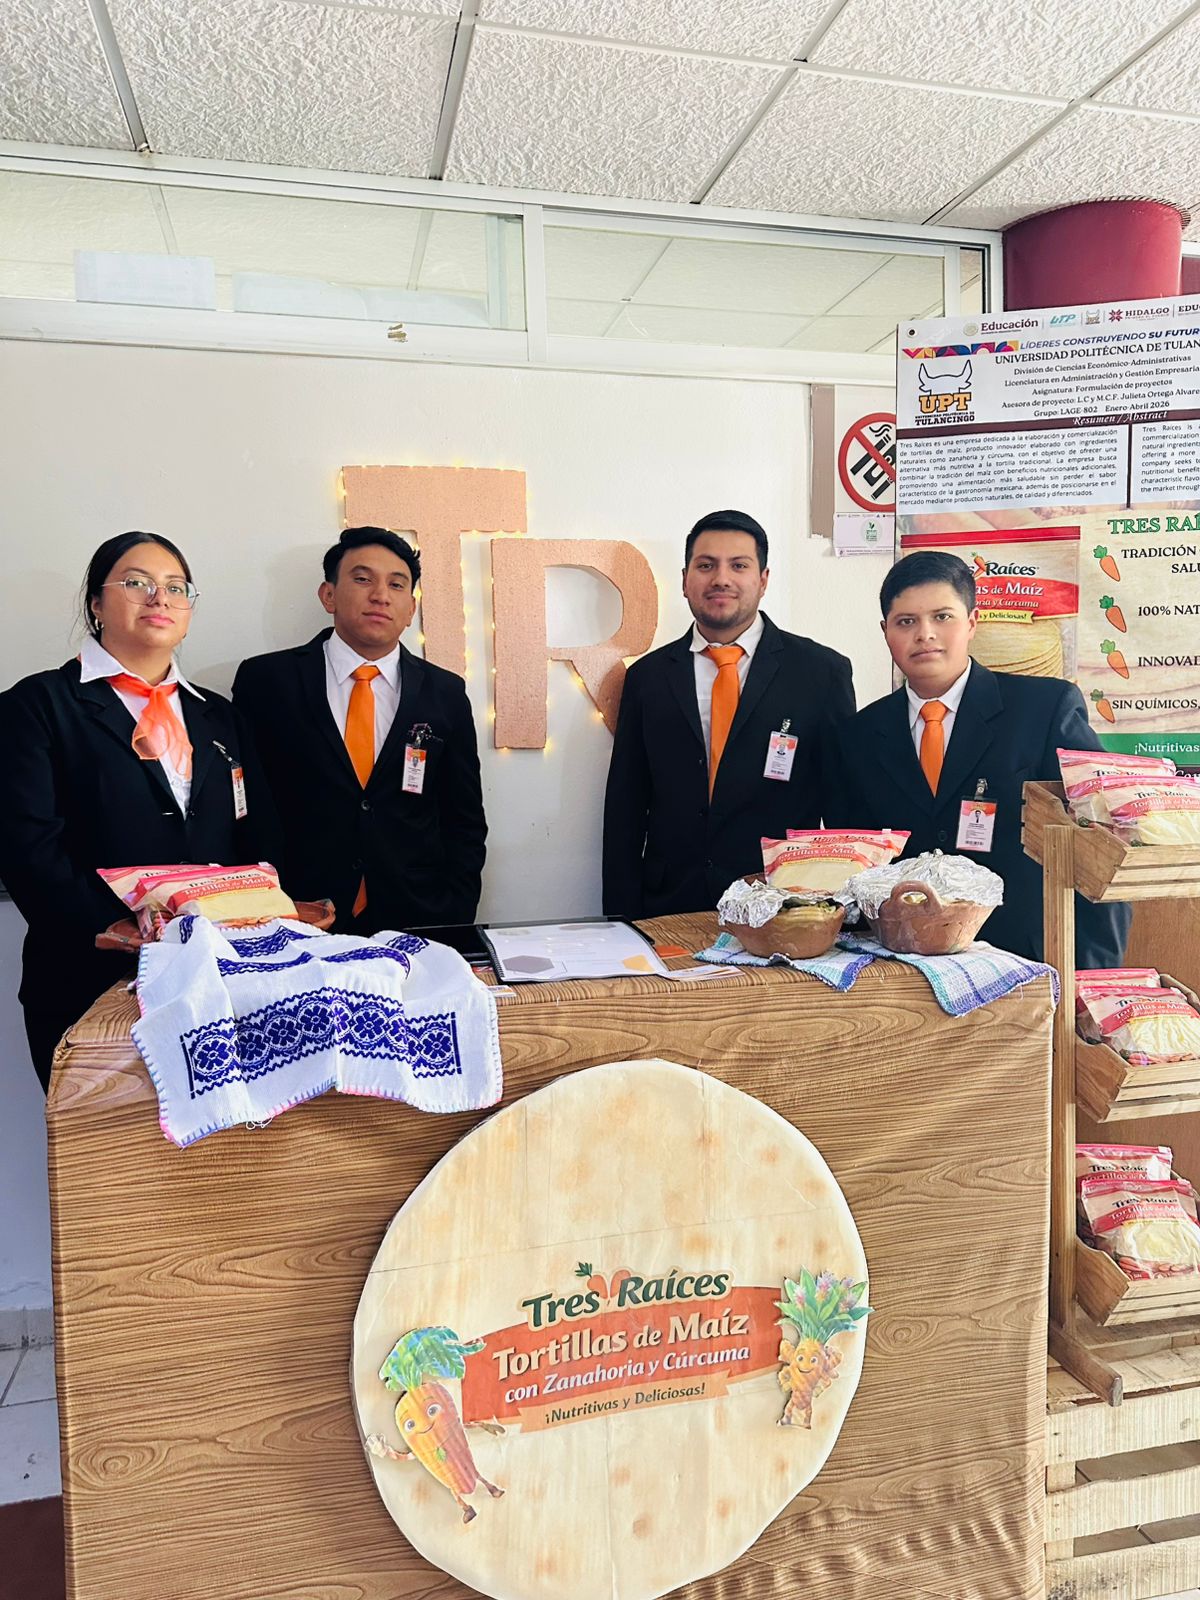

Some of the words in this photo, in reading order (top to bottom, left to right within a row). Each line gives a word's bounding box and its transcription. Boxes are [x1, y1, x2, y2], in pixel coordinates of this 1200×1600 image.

[1125, 307, 1170, 317] HIDALGO
[1178, 304, 1200, 312] EDU
[981, 319, 1039, 331] Educación
[1020, 340, 1061, 350] LÍDERES
[1063, 332, 1147, 346] CONSTRUYENDO
[1148, 331, 1163, 339] SU
[996, 349, 1068, 364] UNIVERSIDAD
[1071, 344, 1144, 359] POLITÉCNICA
[1147, 343, 1162, 352] DE
[1014, 364, 1044, 376] División
[1055, 364, 1086, 372] Ciencias
[1005, 376, 1049, 387] Licenciatura
[1061, 372, 1118, 383] Administración
[1125, 369, 1154, 378] Gestión
[1076, 383, 1123, 393] Formulación
[1135, 380, 1173, 389] proyectos
[919, 392, 972, 414] UPT
[1002, 401, 1031, 409] Asesora
[1120, 391, 1146, 400] Julieta
[1148, 390, 1174, 399] Ortega
[1150, 401, 1170, 409] 2026
[915, 415, 975, 426] TULANCINGO
[1073, 416, 1116, 426] Resumen
[1123, 411, 1168, 423] Abstract
[1142, 433, 1199, 442] commercialization
[966, 444, 994, 453] producto
[1030, 441, 1061, 449] elaborado
[1041, 449, 1066, 458] objetivo
[1080, 446, 1102, 454] ofrecer
[1142, 451, 1167, 459] offering
[1007, 466, 1038, 474] beneficios
[1141, 476, 1183, 484] characteristic
[1107, 517, 1161, 535] TRES
[1121, 544, 1197, 559] TRADICIÓN
[985, 562, 1037, 576] Raíces
[991, 587, 1003, 595] de
[1005, 582, 1044, 596] Maíz
[989, 612, 1027, 620] Deliciosas!
[1138, 606, 1171, 617] 100%
[1112, 700, 1133, 709] SIN
[1135, 743, 1200, 755] ¡Nutritivas
[522, 1289, 600, 1329] Tres
[617, 1270, 730, 1308] Raíces
[492, 1328, 628, 1381] Tortillas
[633, 1325, 662, 1351] de
[667, 1307, 750, 1345] Maíz
[504, 1383, 539, 1404] con
[542, 1359, 645, 1396] Zanahoria
[647, 1359, 659, 1377] y
[662, 1345, 750, 1371] Cúrcuma
[545, 1397, 619, 1425] ¡Nutritivas
[623, 1397, 631, 1410] y
[634, 1383, 706, 1405] Deliciosas!
